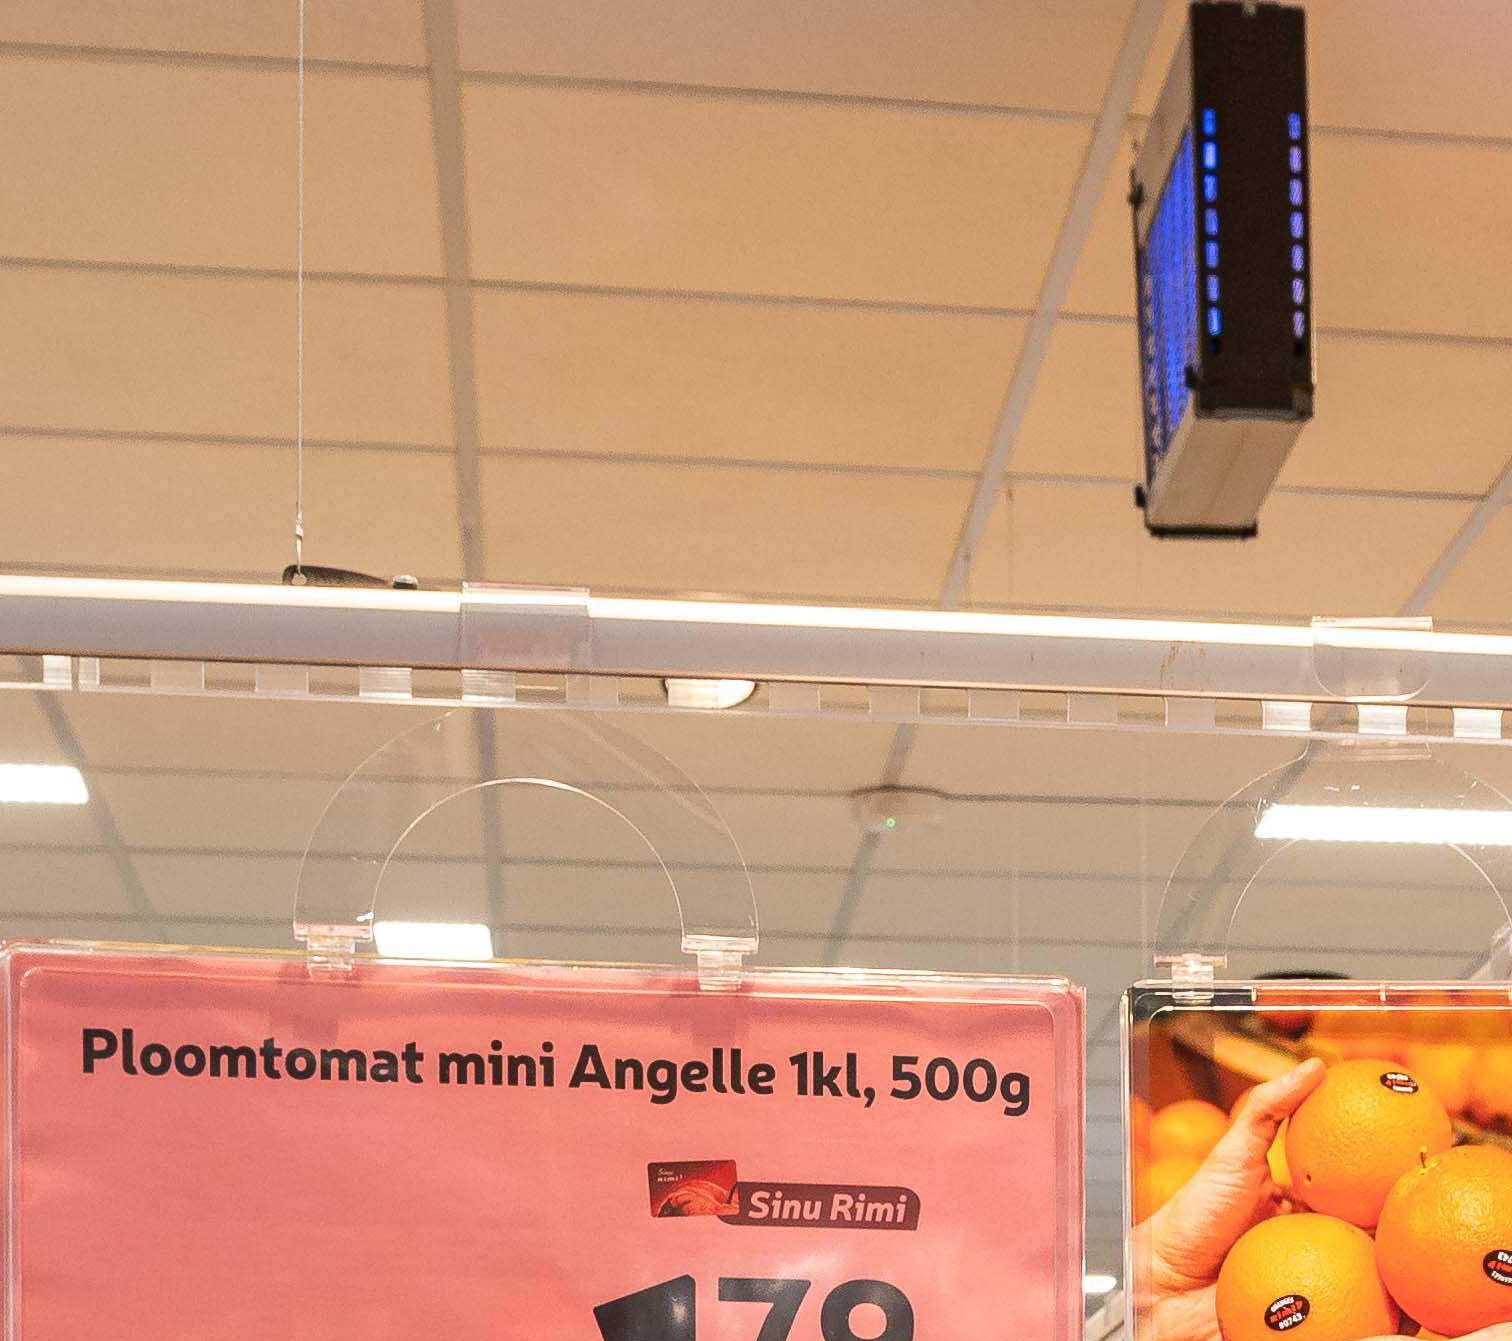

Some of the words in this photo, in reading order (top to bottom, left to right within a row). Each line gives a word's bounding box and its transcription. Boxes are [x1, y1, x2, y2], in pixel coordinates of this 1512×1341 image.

[82, 1027, 425, 1084] Ploomtomat
[438, 1039, 555, 1088] mini
[568, 1044, 776, 1105] Angelle
[788, 1051, 876, 1108] 1kl,
[889, 1055, 1030, 1117] 500g
[747, 1190, 823, 1221] Sinu
[829, 1193, 908, 1223] Rimi
